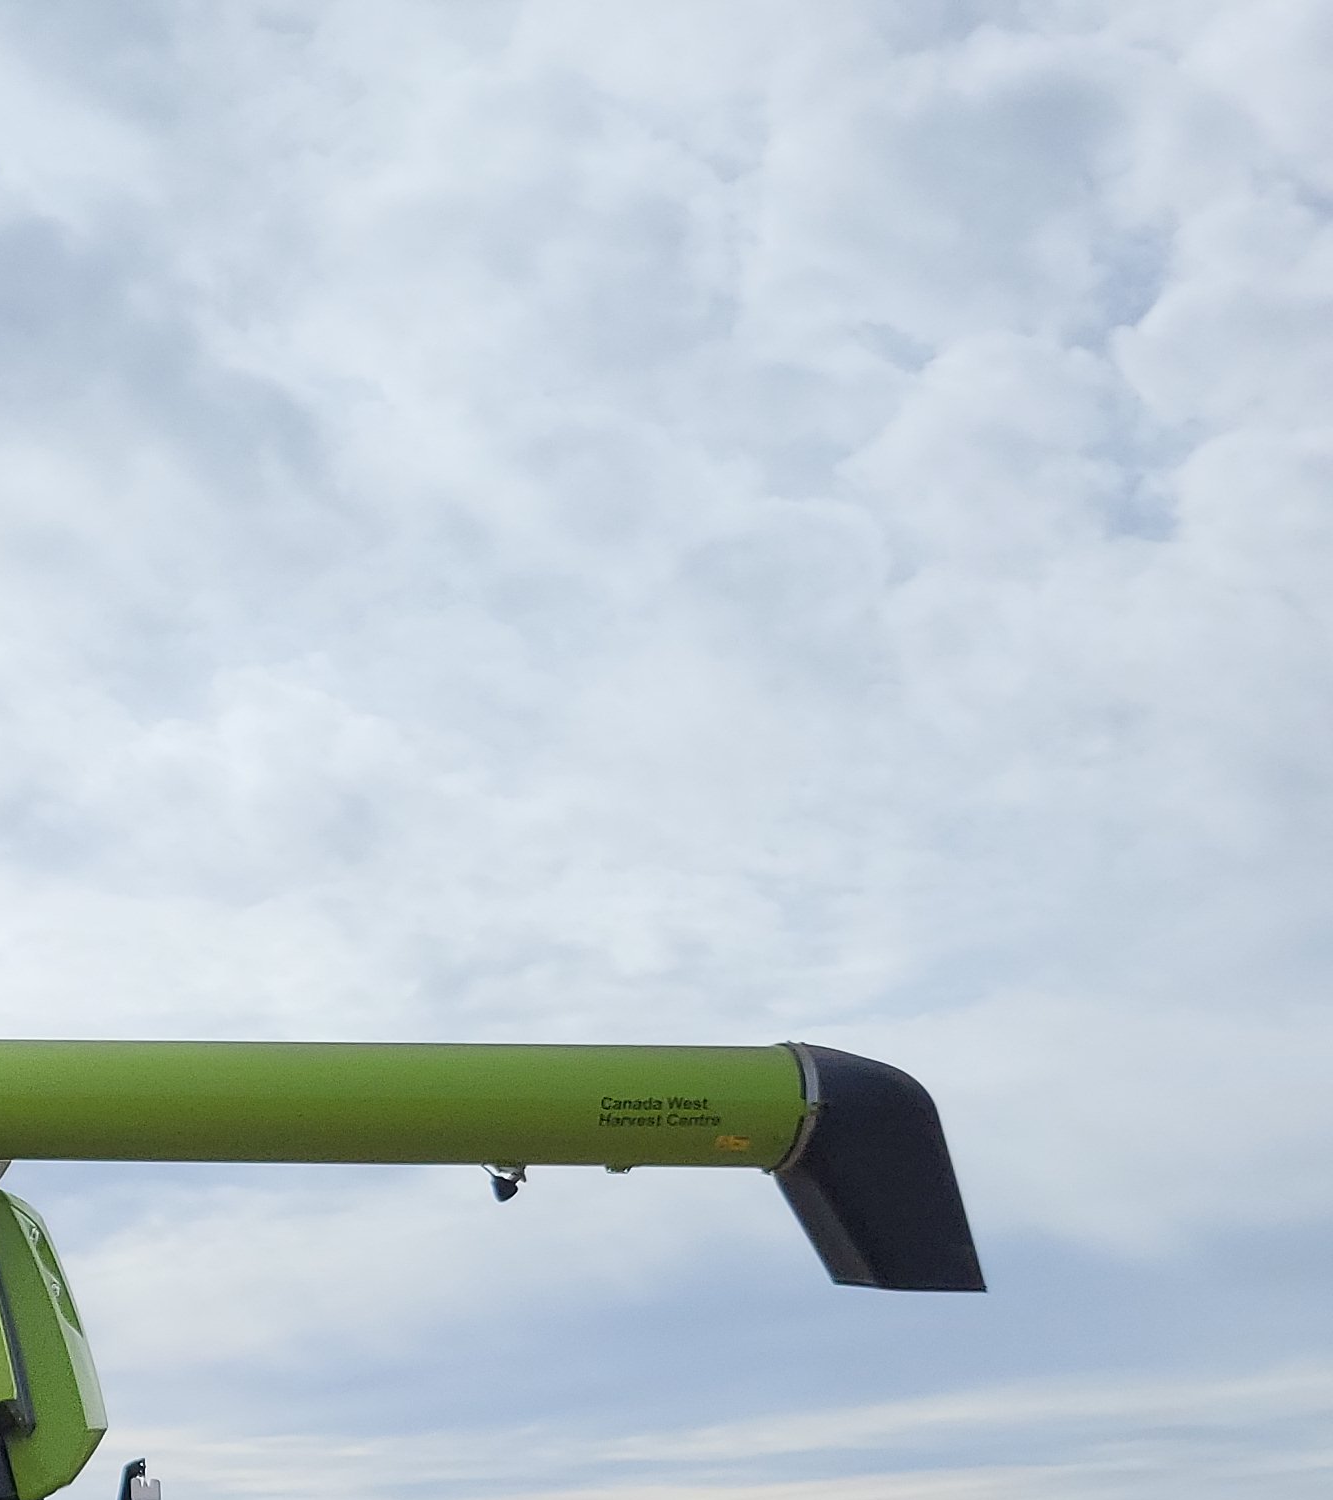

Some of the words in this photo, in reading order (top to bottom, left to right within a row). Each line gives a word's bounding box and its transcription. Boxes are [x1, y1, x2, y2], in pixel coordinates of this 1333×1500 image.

[601, 1096, 662, 1110] Canada
[667, 1096, 708, 1110] West
[599, 1113, 661, 1126] Harvest
[666, 1113, 720, 1126] Centre
